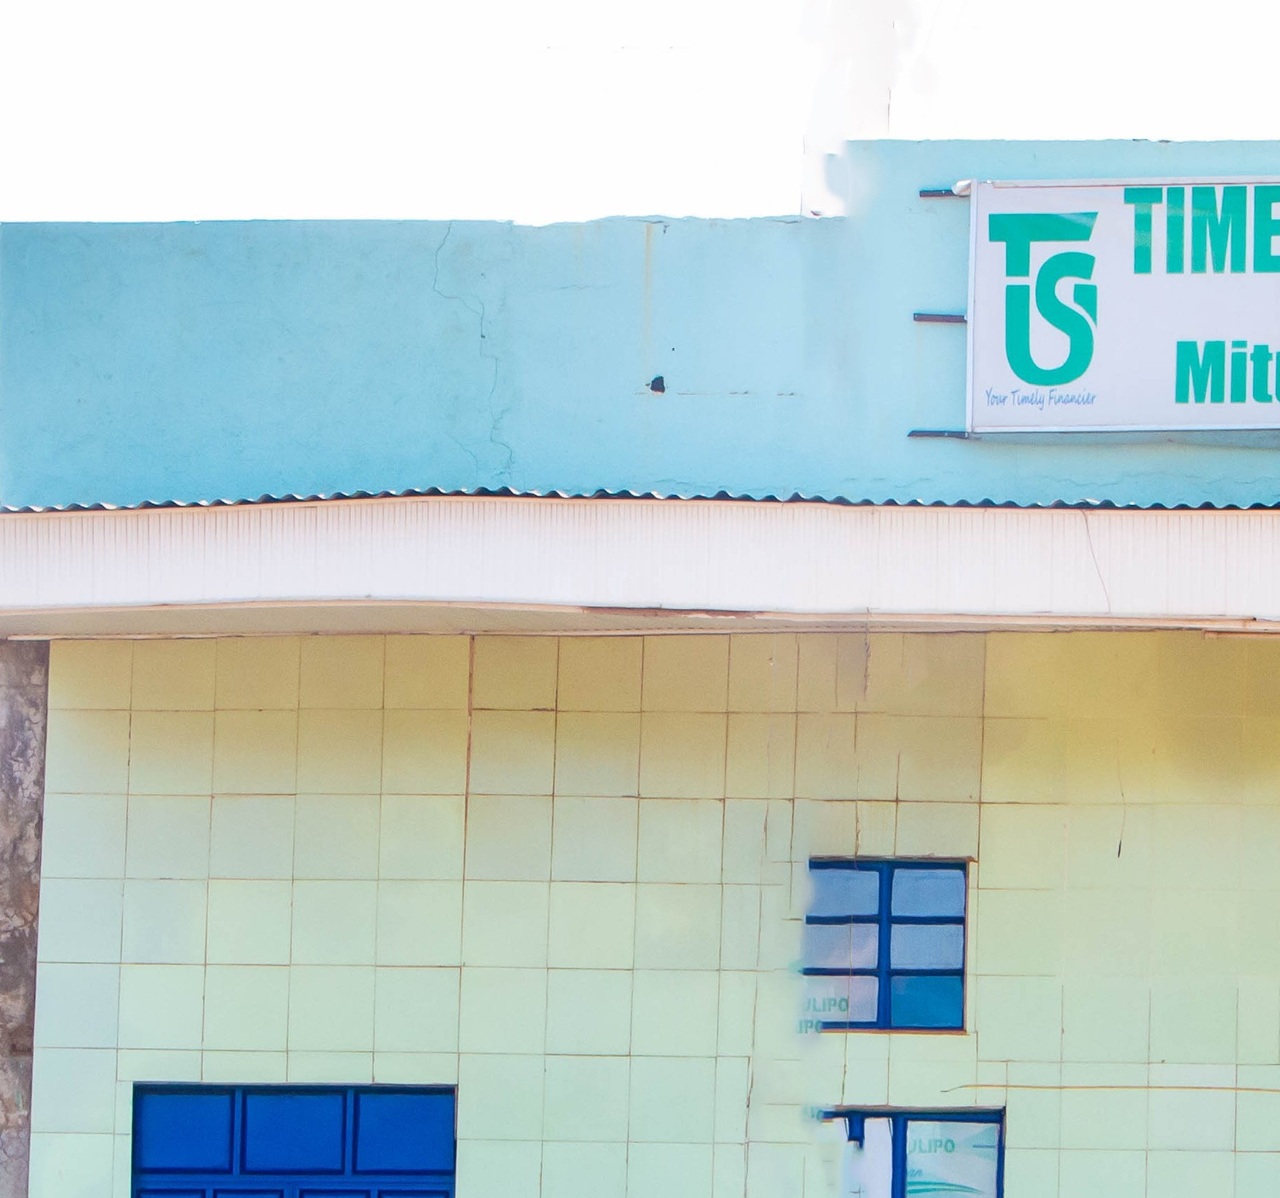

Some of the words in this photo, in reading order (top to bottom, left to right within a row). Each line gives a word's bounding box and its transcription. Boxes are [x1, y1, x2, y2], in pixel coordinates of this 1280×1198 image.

[985, 387, 1008, 406] Your
[1011, 388, 1045, 411] Timely
[1048, 388, 1097, 406] Financier
